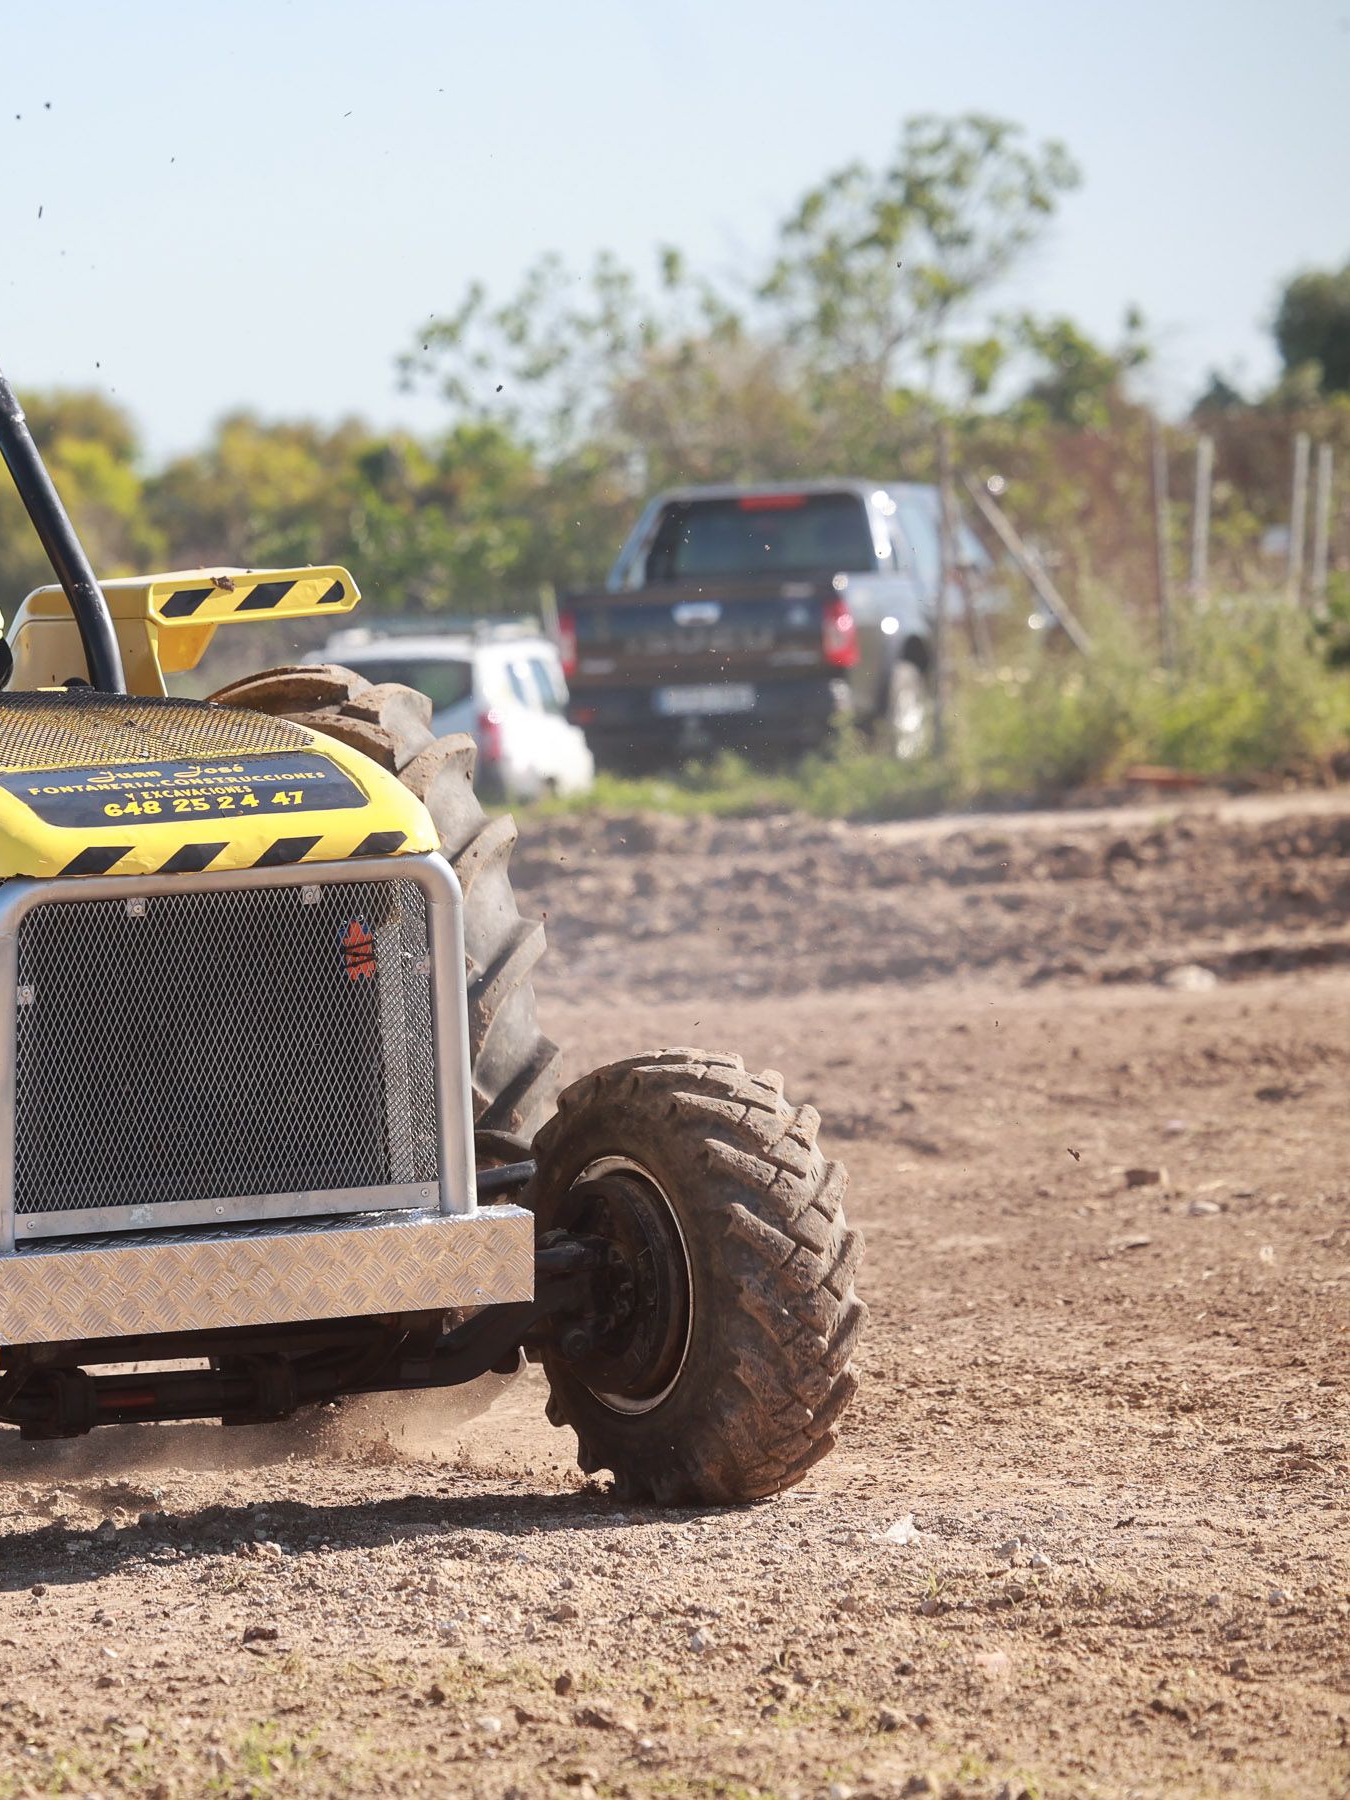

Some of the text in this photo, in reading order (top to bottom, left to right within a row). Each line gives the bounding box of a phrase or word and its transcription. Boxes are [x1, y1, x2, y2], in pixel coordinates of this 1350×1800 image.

[87, 764, 245, 783] Juan José
[141, 785, 253, 800] EXCAVACIONES
[104, 800, 163, 817] 648
[172, 797, 211, 813] 25
[271, 790, 304, 806] 47
